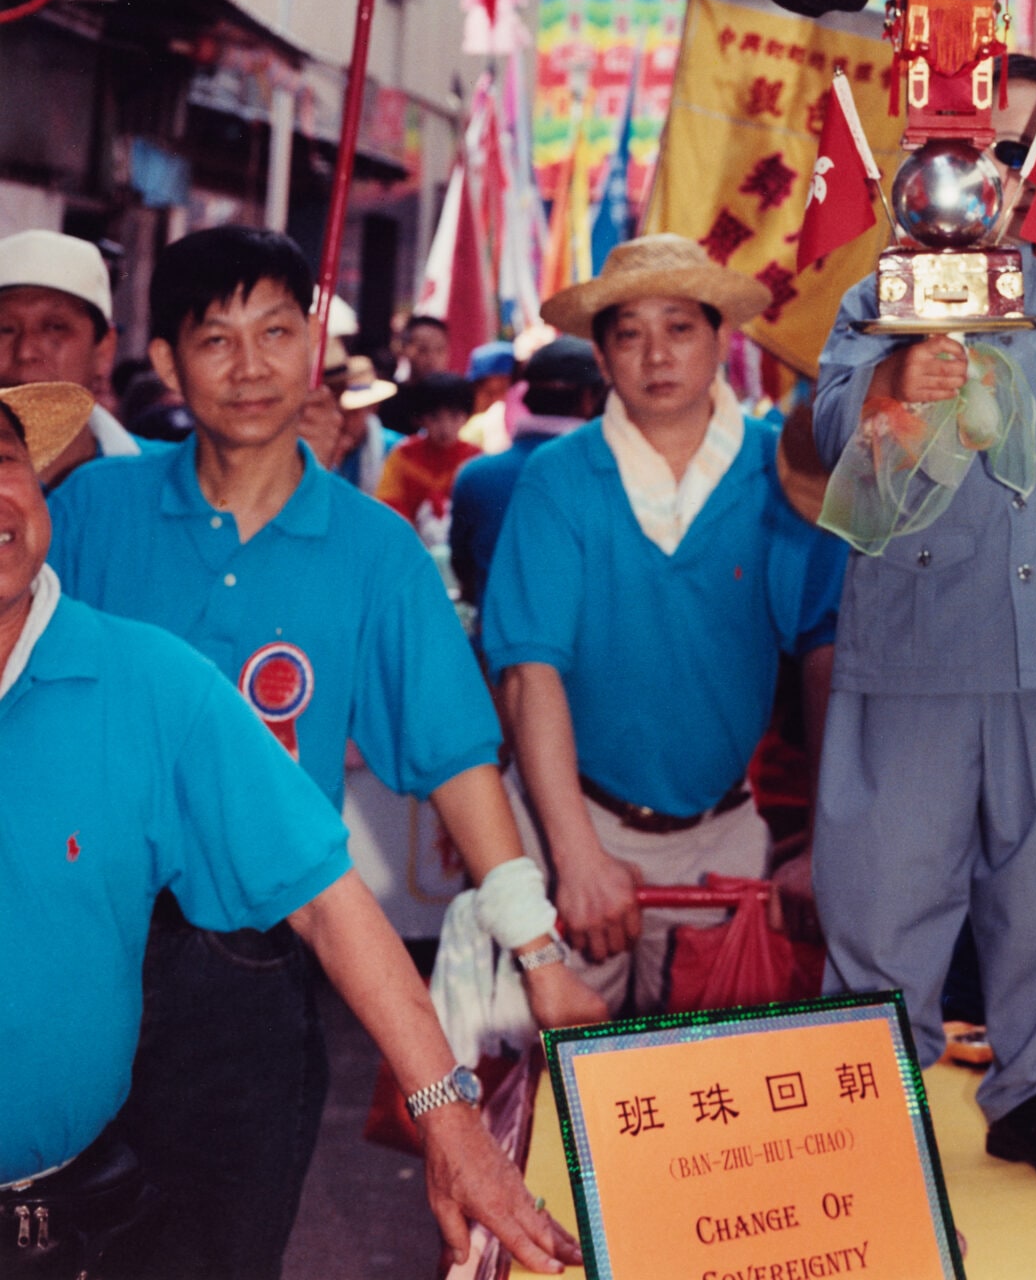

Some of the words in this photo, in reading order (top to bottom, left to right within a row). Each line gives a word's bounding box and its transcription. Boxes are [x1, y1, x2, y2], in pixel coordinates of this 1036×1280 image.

[615, 1061, 880, 1137] 班珠回朝
[668, 1127, 855, 1181] (BAN-ZHU-HUI-CHAO)
